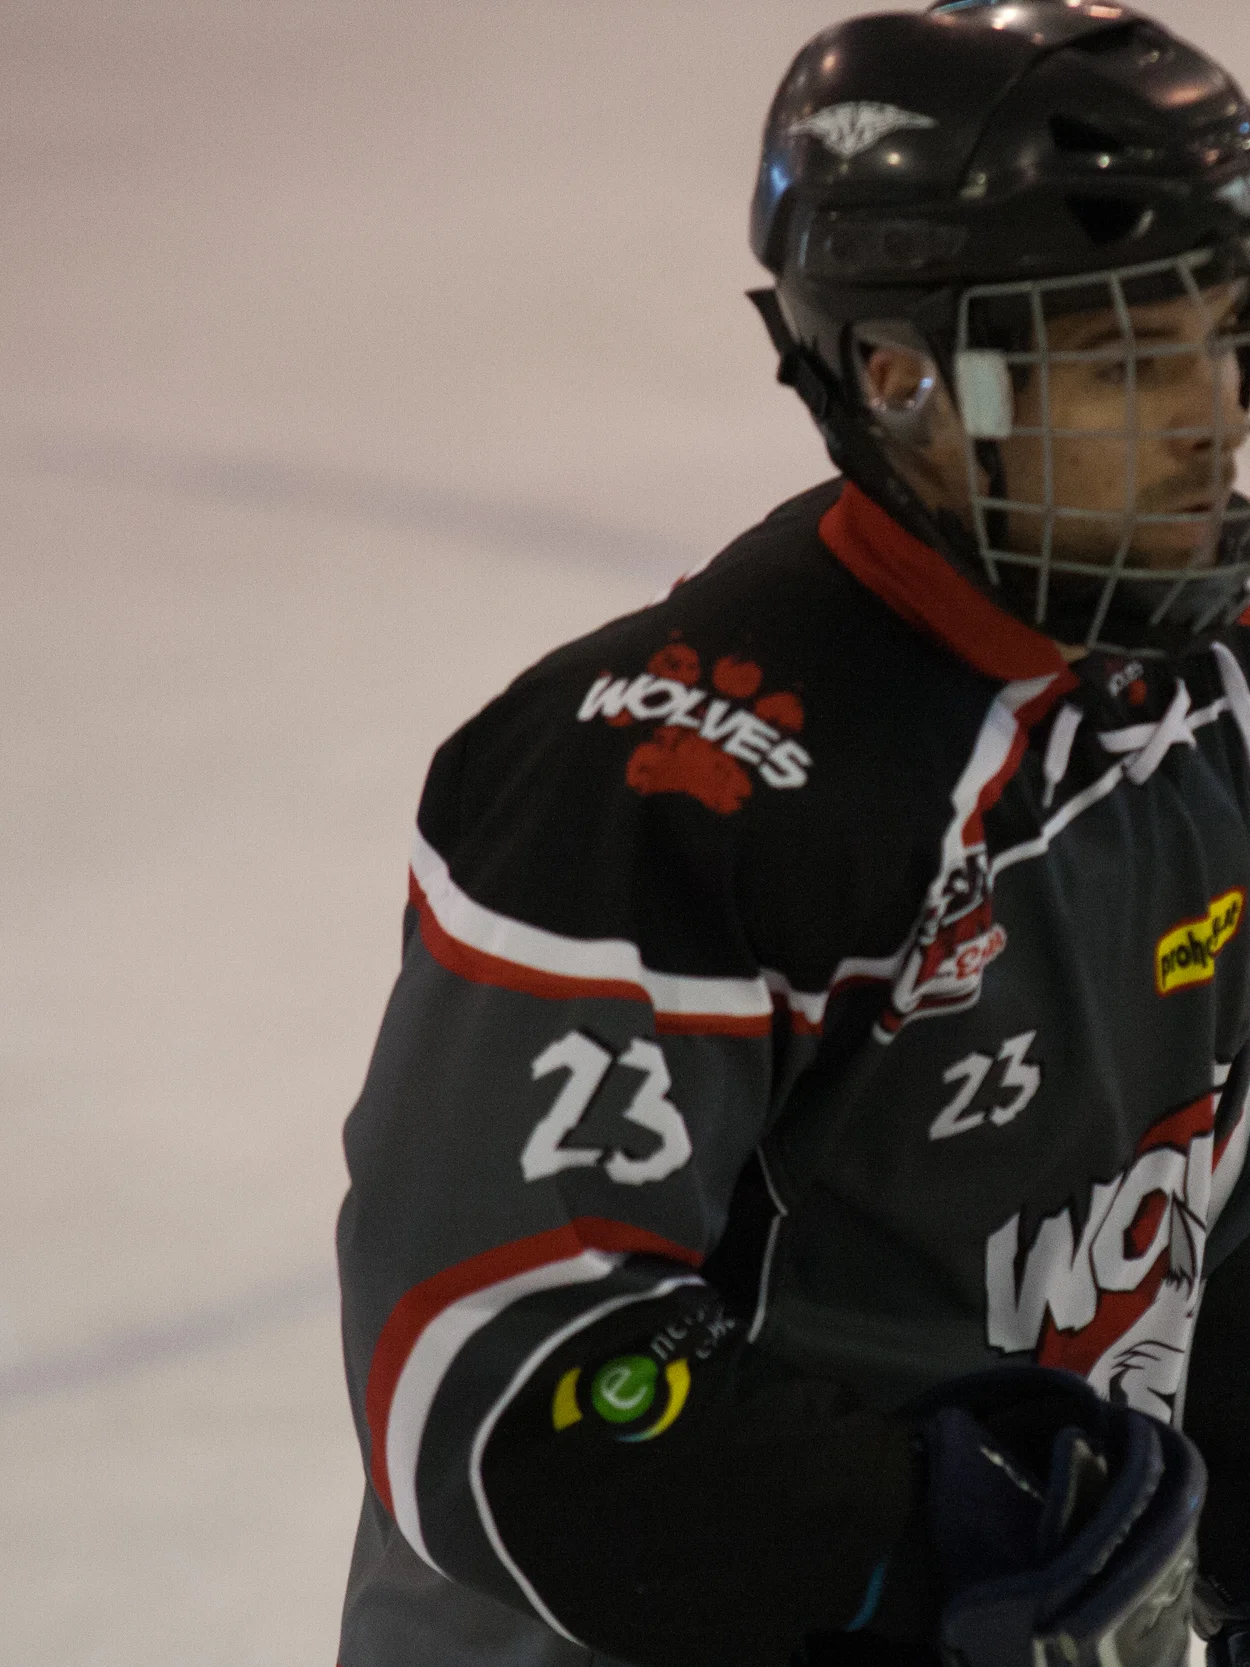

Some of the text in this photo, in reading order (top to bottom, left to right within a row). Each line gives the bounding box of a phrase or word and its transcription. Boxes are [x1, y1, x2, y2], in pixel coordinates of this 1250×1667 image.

[576, 673, 813, 791] WOLVES
[520, 1029, 693, 1187] 23
[928, 1030, 1042, 1141] 23
[600, 1364, 649, 1410] e
